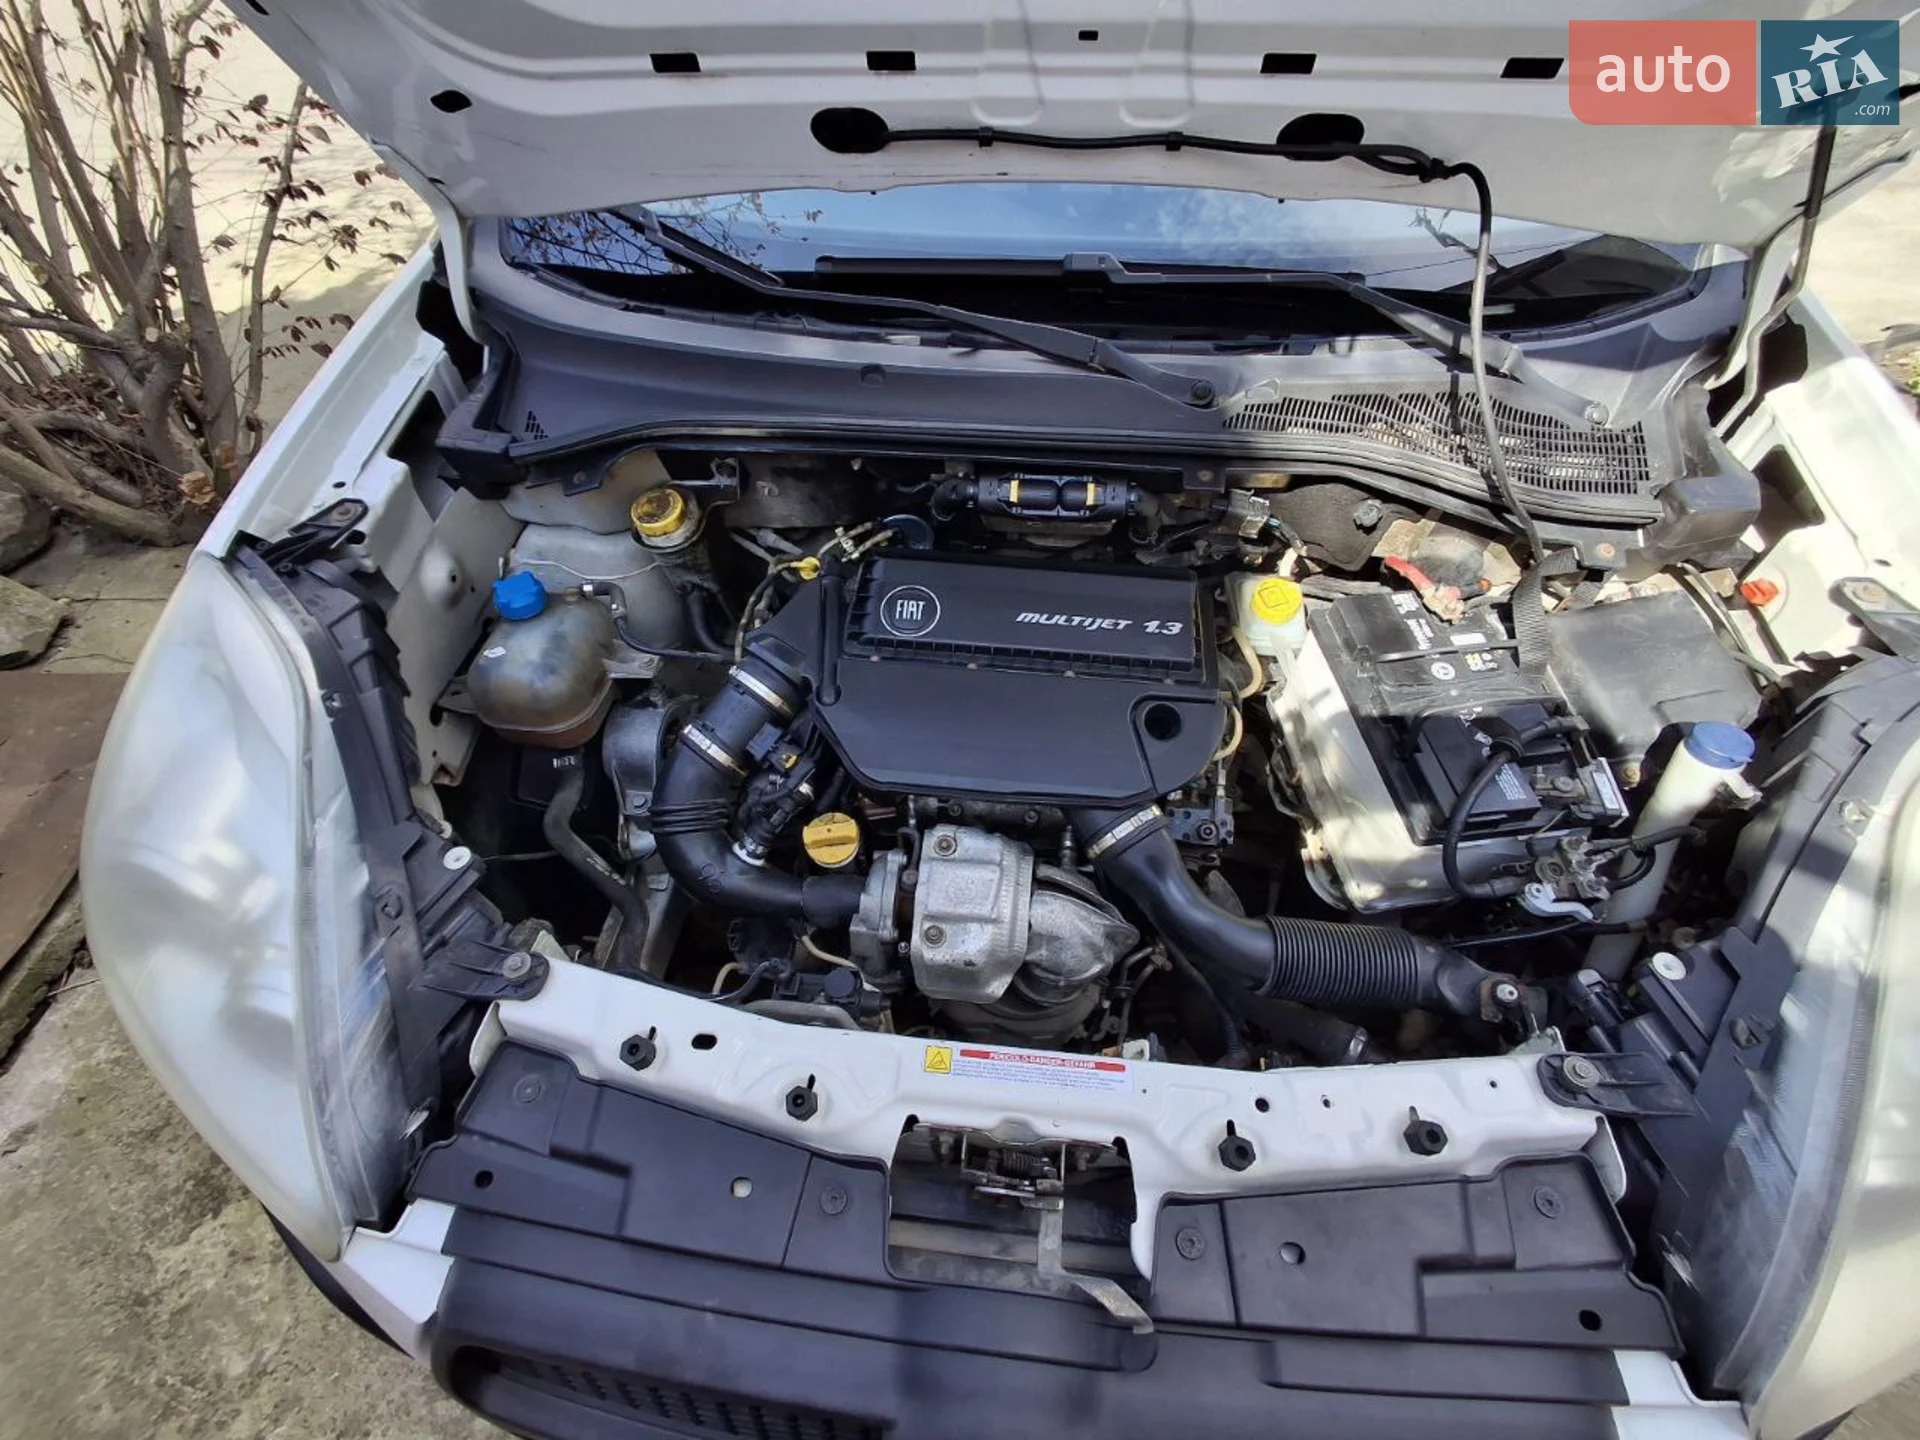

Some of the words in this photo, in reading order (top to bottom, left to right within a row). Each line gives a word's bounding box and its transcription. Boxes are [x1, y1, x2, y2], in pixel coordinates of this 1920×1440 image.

[896, 599, 925, 620] FIAT
[1016, 612, 1132, 630] MULTIJET
[1143, 620, 1183, 635] 1.3
